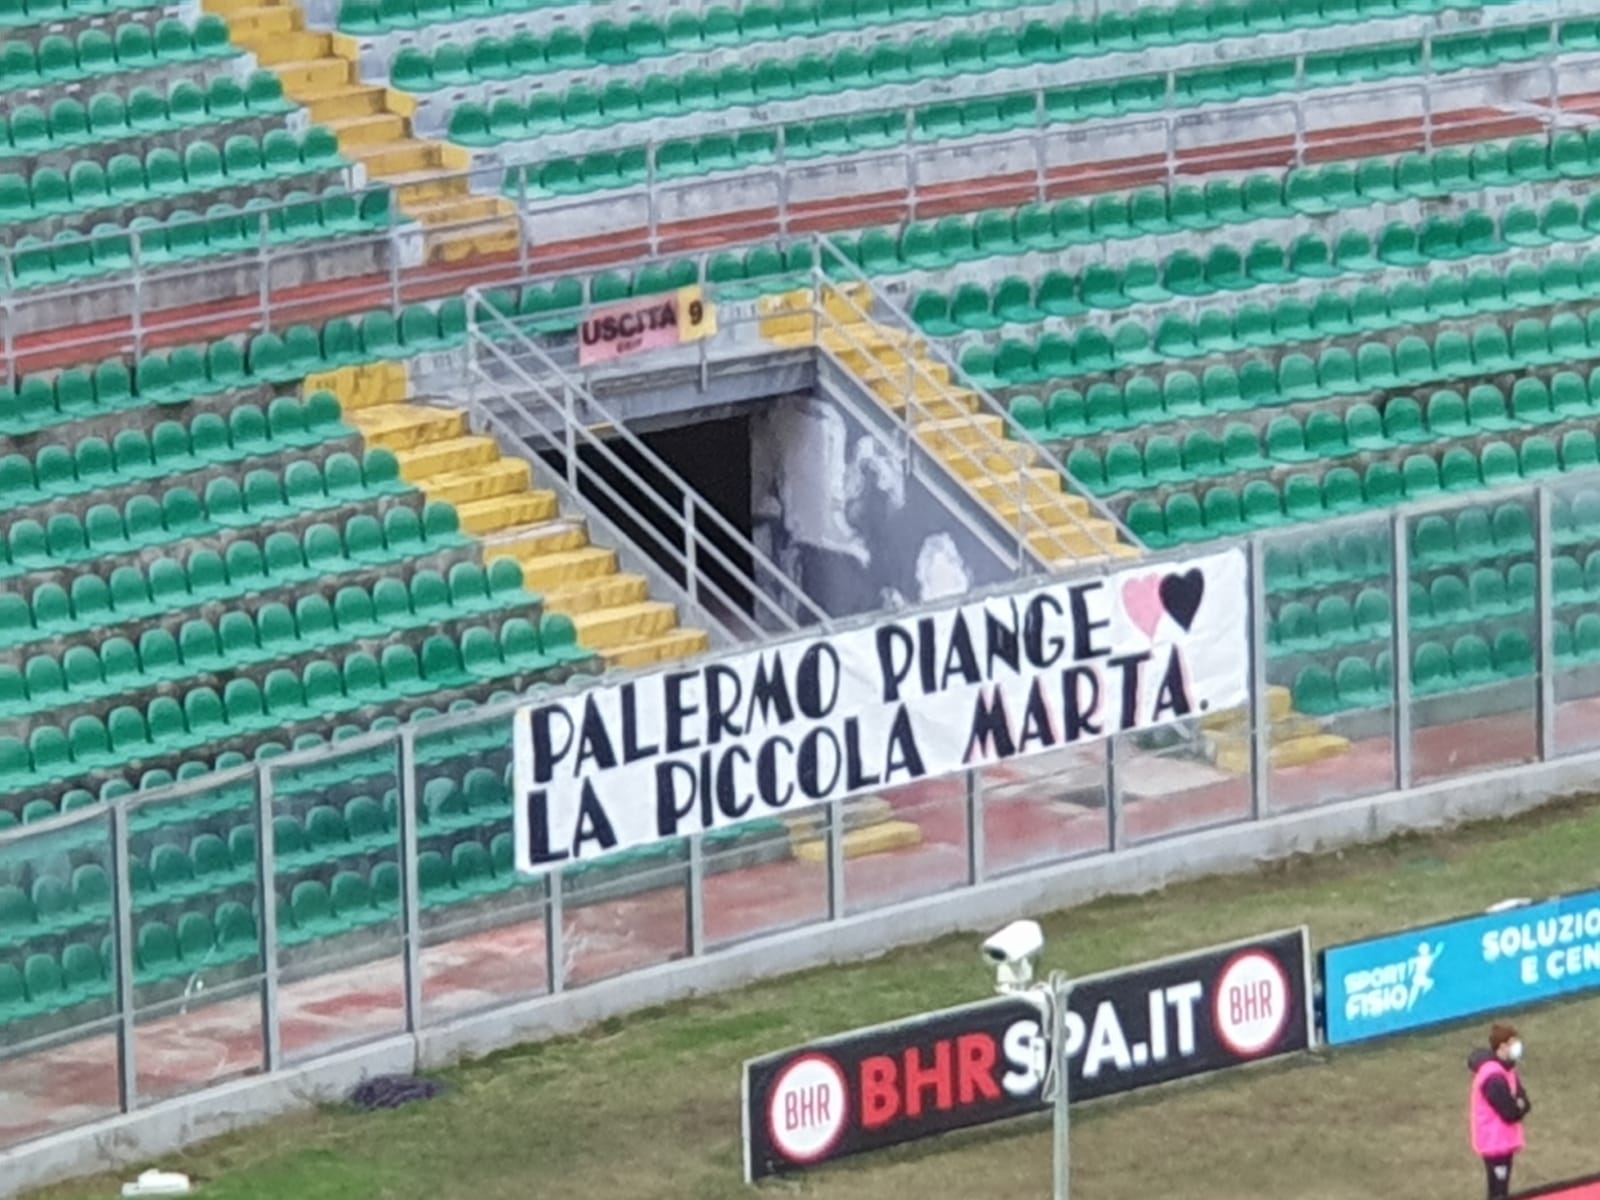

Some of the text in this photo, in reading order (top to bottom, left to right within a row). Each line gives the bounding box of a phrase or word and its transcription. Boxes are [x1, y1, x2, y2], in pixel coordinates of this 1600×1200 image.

[581, 298, 678, 346] USCITA
[688, 299, 704, 326] 9
[529, 580, 1112, 784] PALERMO PIANGE
[527, 643, 1209, 866] LA PICCOLA MARTA.
[1481, 908, 1600, 963] SOLUZIO
[1520, 954, 1540, 985] E
[1229, 979, 1273, 1026] BHR
[784, 1083, 831, 1132] BHR
